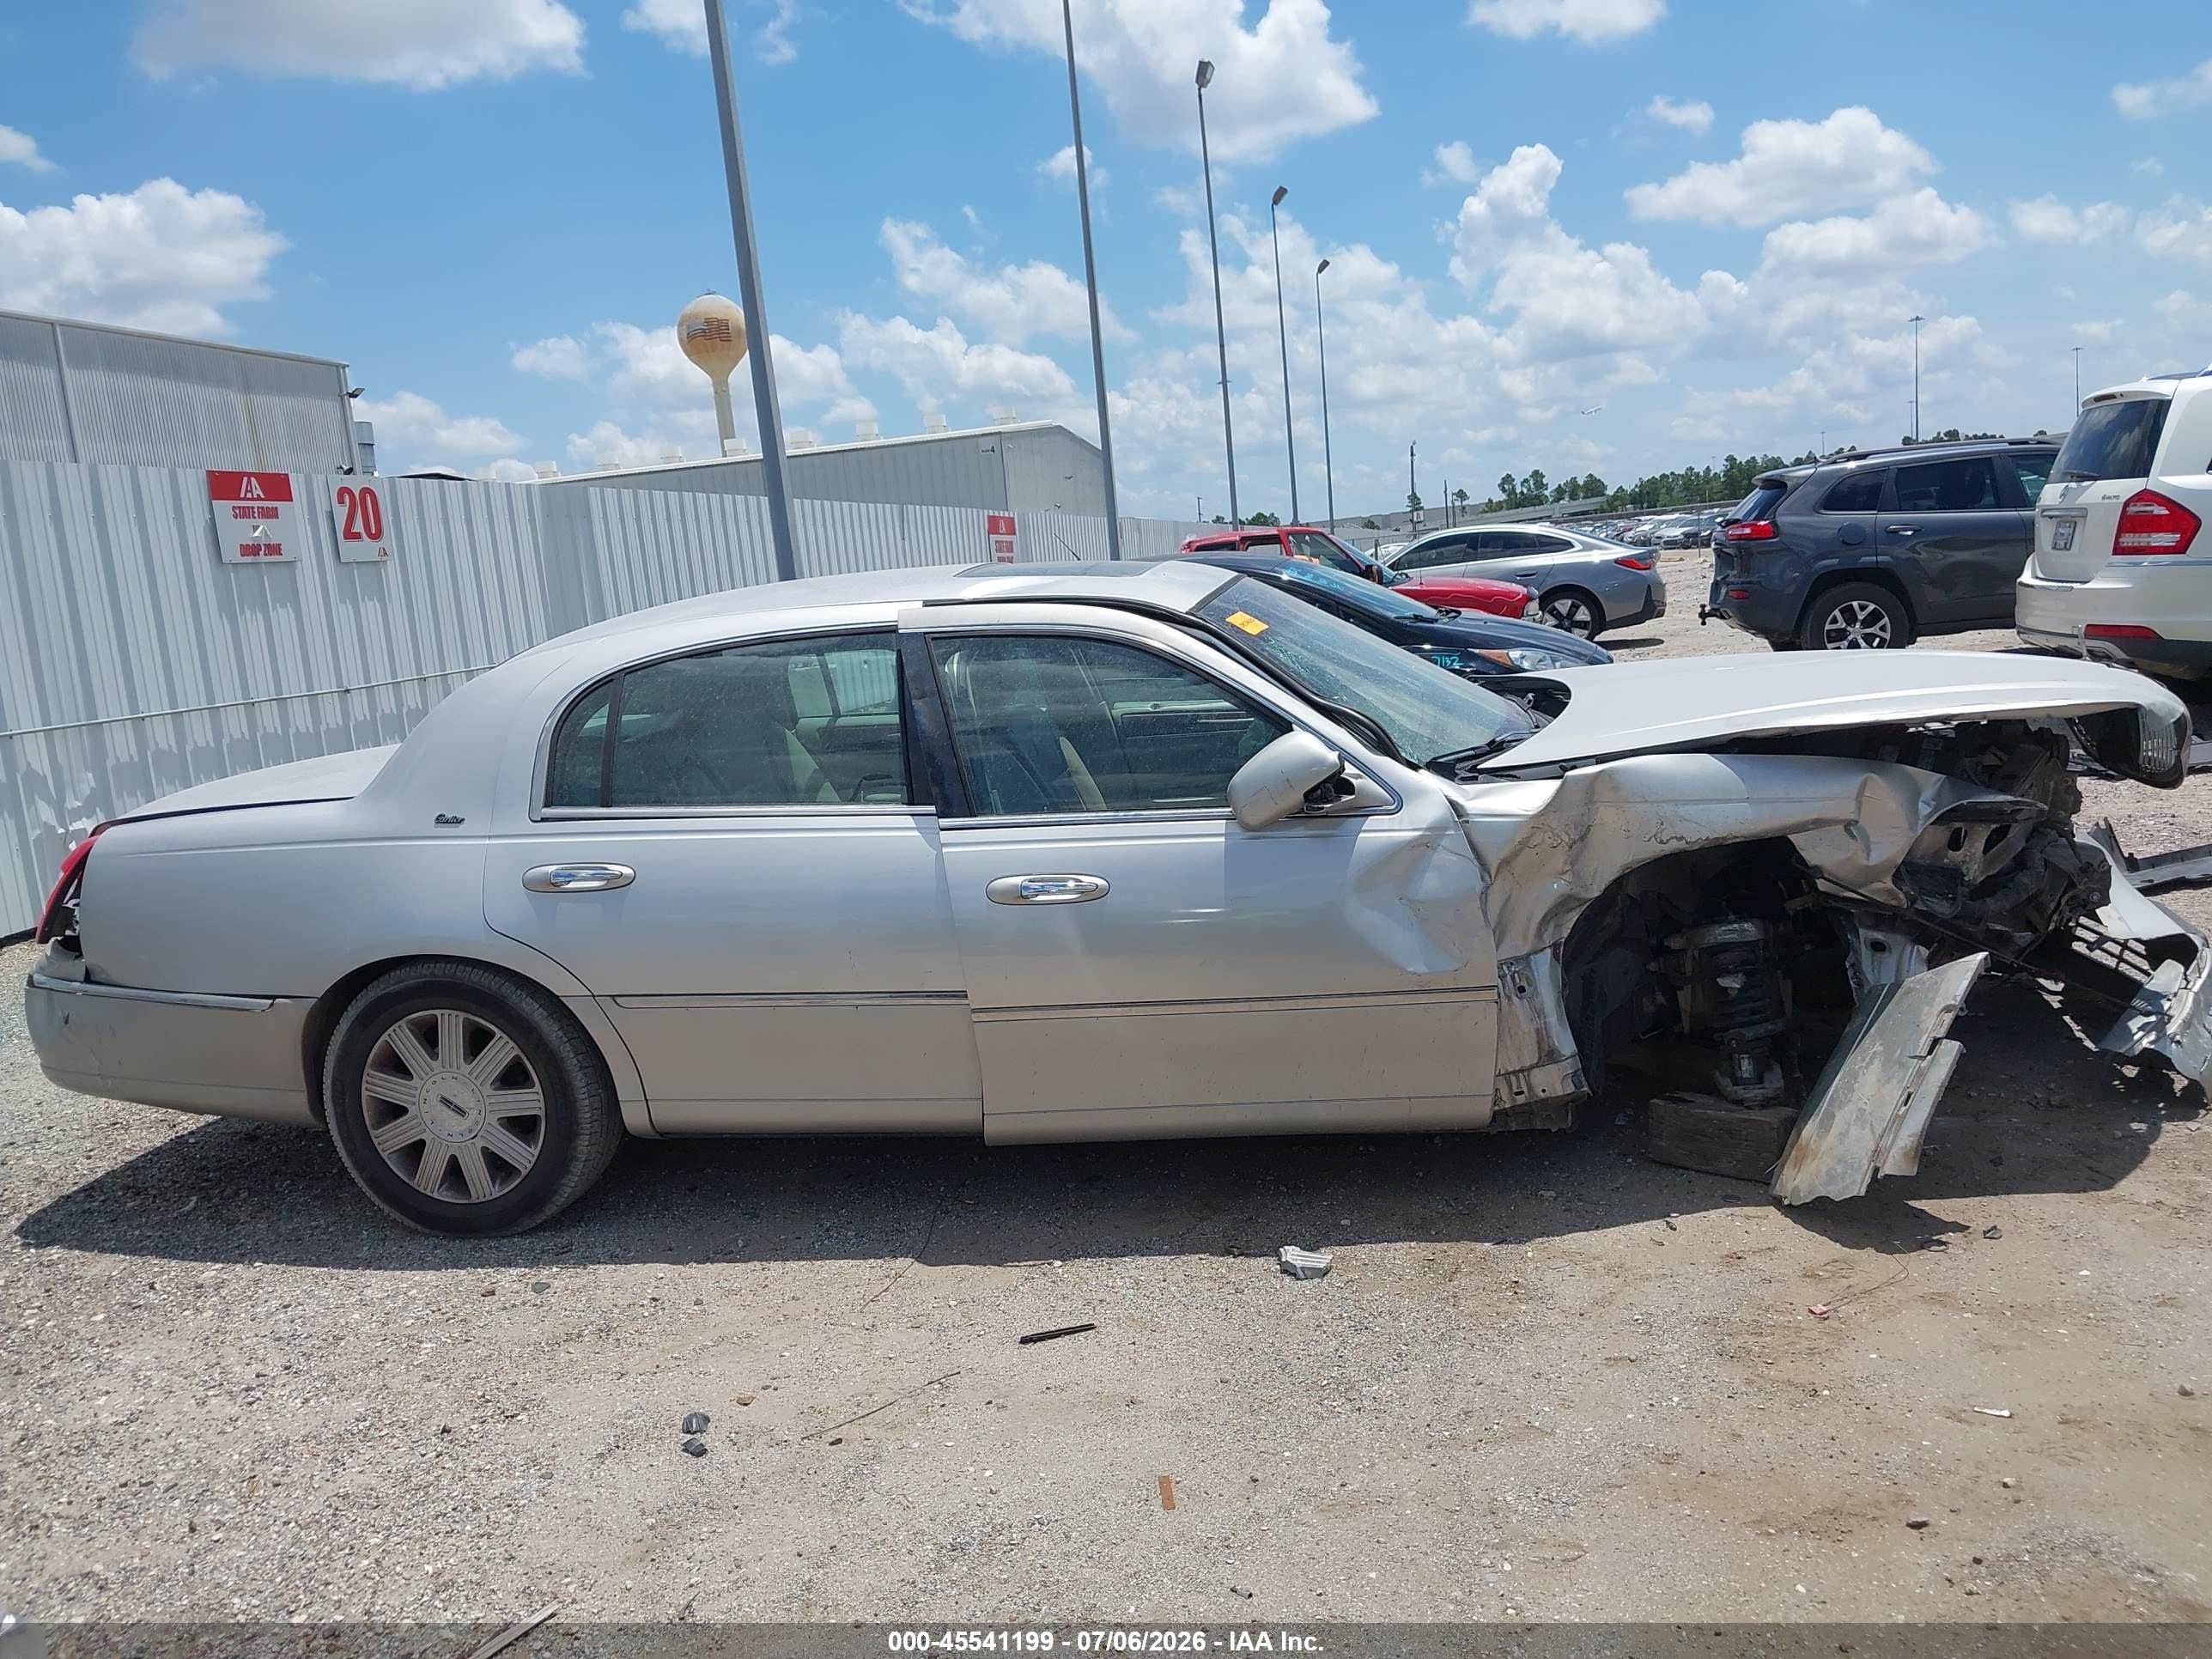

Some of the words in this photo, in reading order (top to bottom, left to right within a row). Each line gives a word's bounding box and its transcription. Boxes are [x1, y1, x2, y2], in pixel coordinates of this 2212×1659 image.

[231, 505, 256, 520] STATE
[258, 506, 279, 520] FARM
[337, 486, 383, 541] 20
[240, 543, 262, 556] DROP
[263, 543, 283, 556] ZONE
